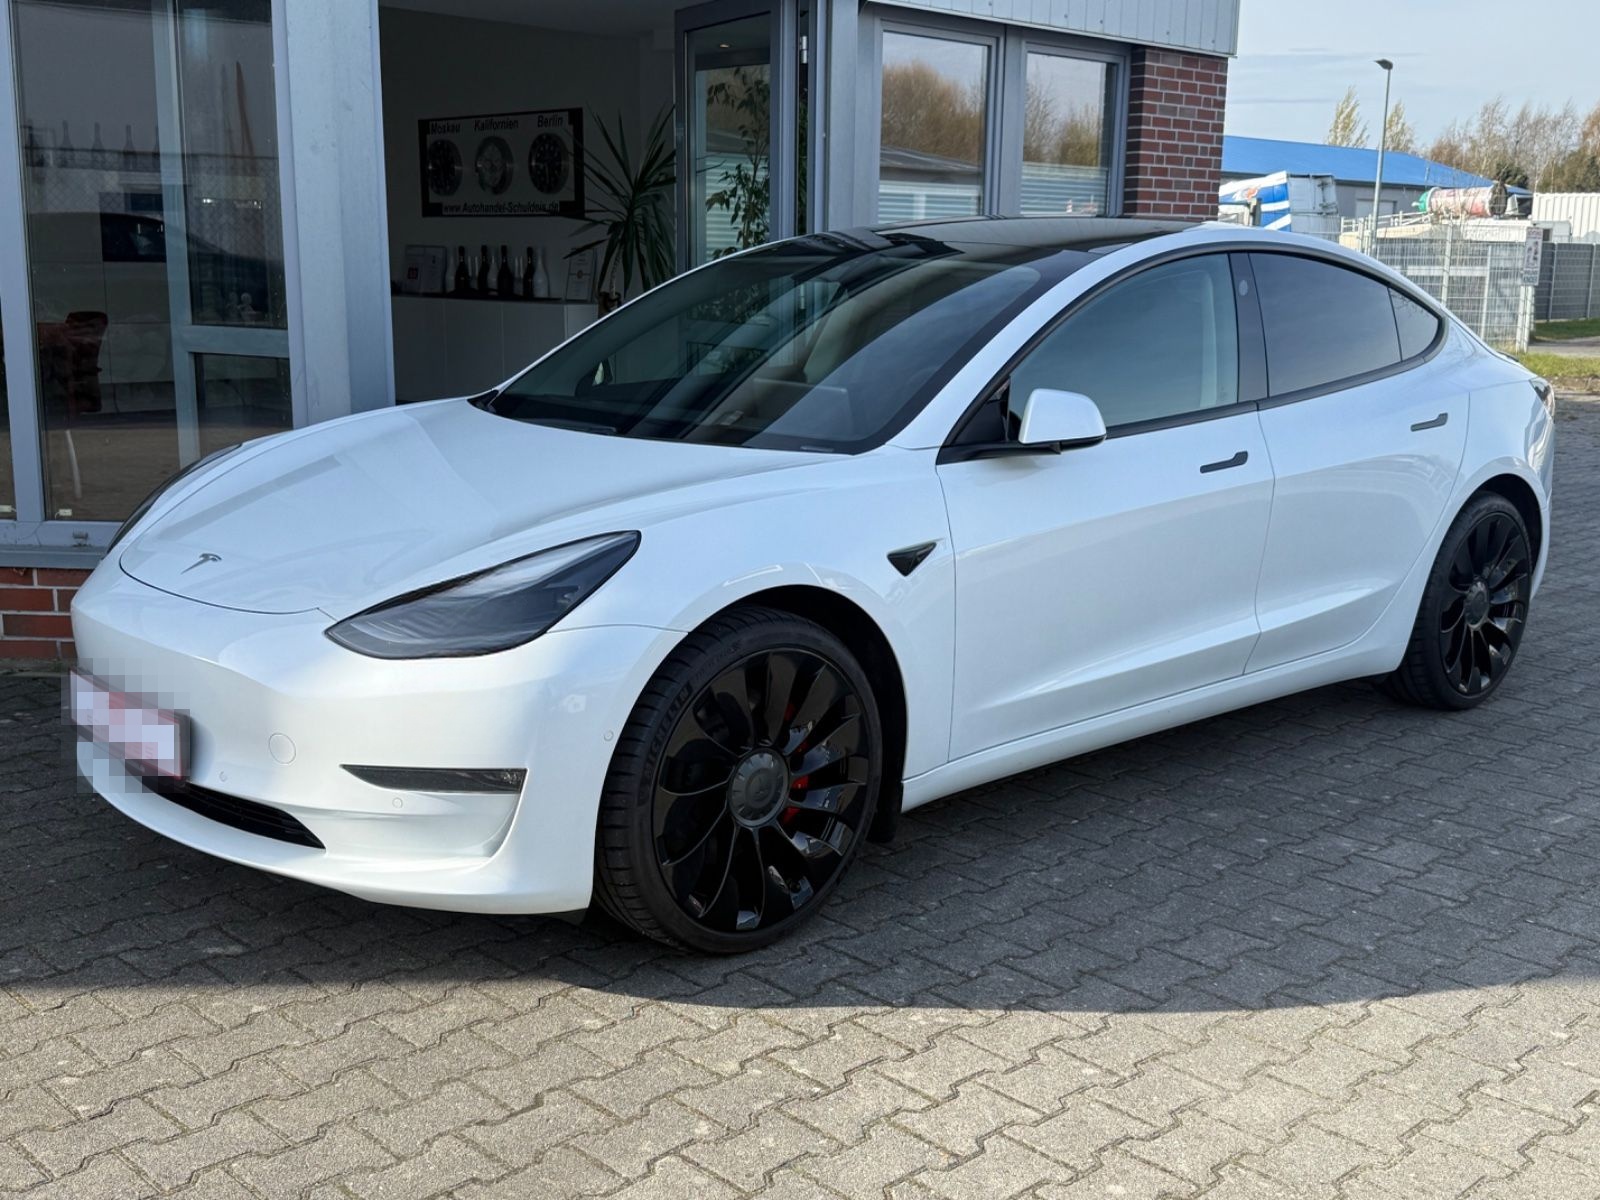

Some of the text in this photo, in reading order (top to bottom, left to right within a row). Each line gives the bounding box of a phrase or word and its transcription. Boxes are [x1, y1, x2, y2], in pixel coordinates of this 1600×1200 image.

[430, 114, 564, 135] Moskau Kalifornien Berlin
